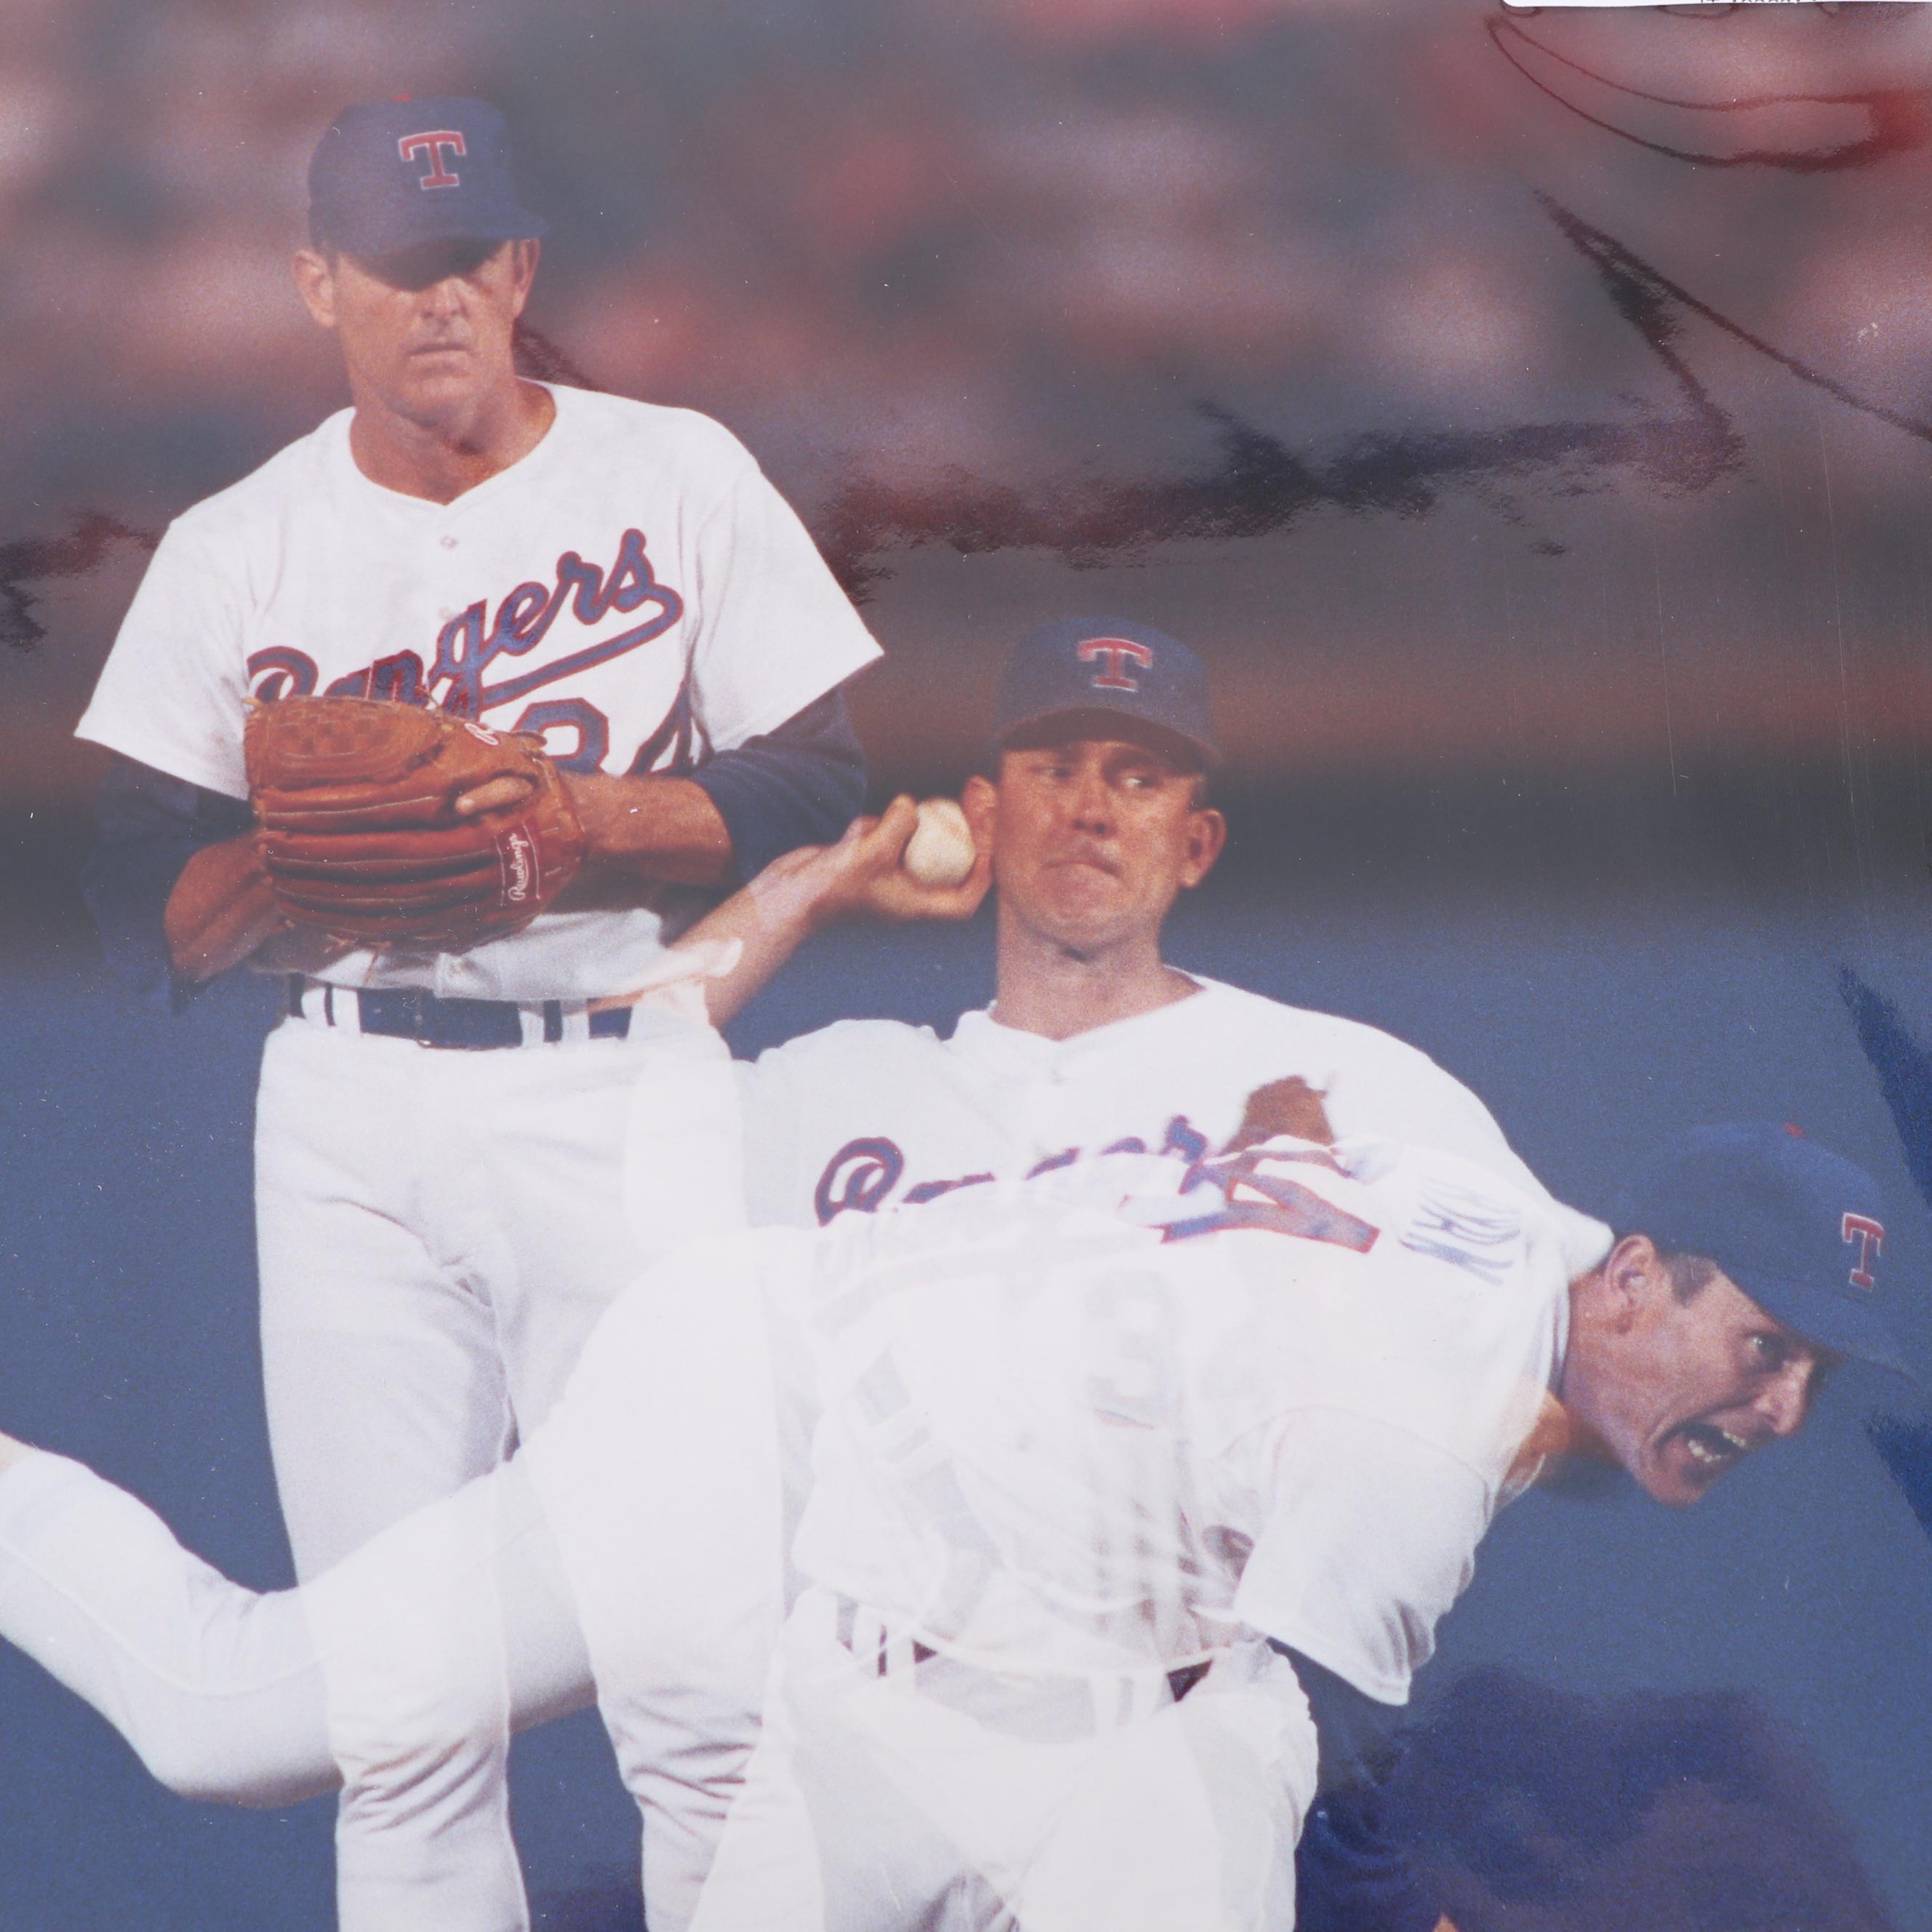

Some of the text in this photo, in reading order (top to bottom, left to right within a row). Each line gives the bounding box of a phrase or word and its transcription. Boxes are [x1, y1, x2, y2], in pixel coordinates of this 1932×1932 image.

[398, 129, 467, 191] T
[1076, 637, 1154, 692] T
[508, 832, 530, 901] Rawlings
[1841, 1211, 1886, 1292] T
